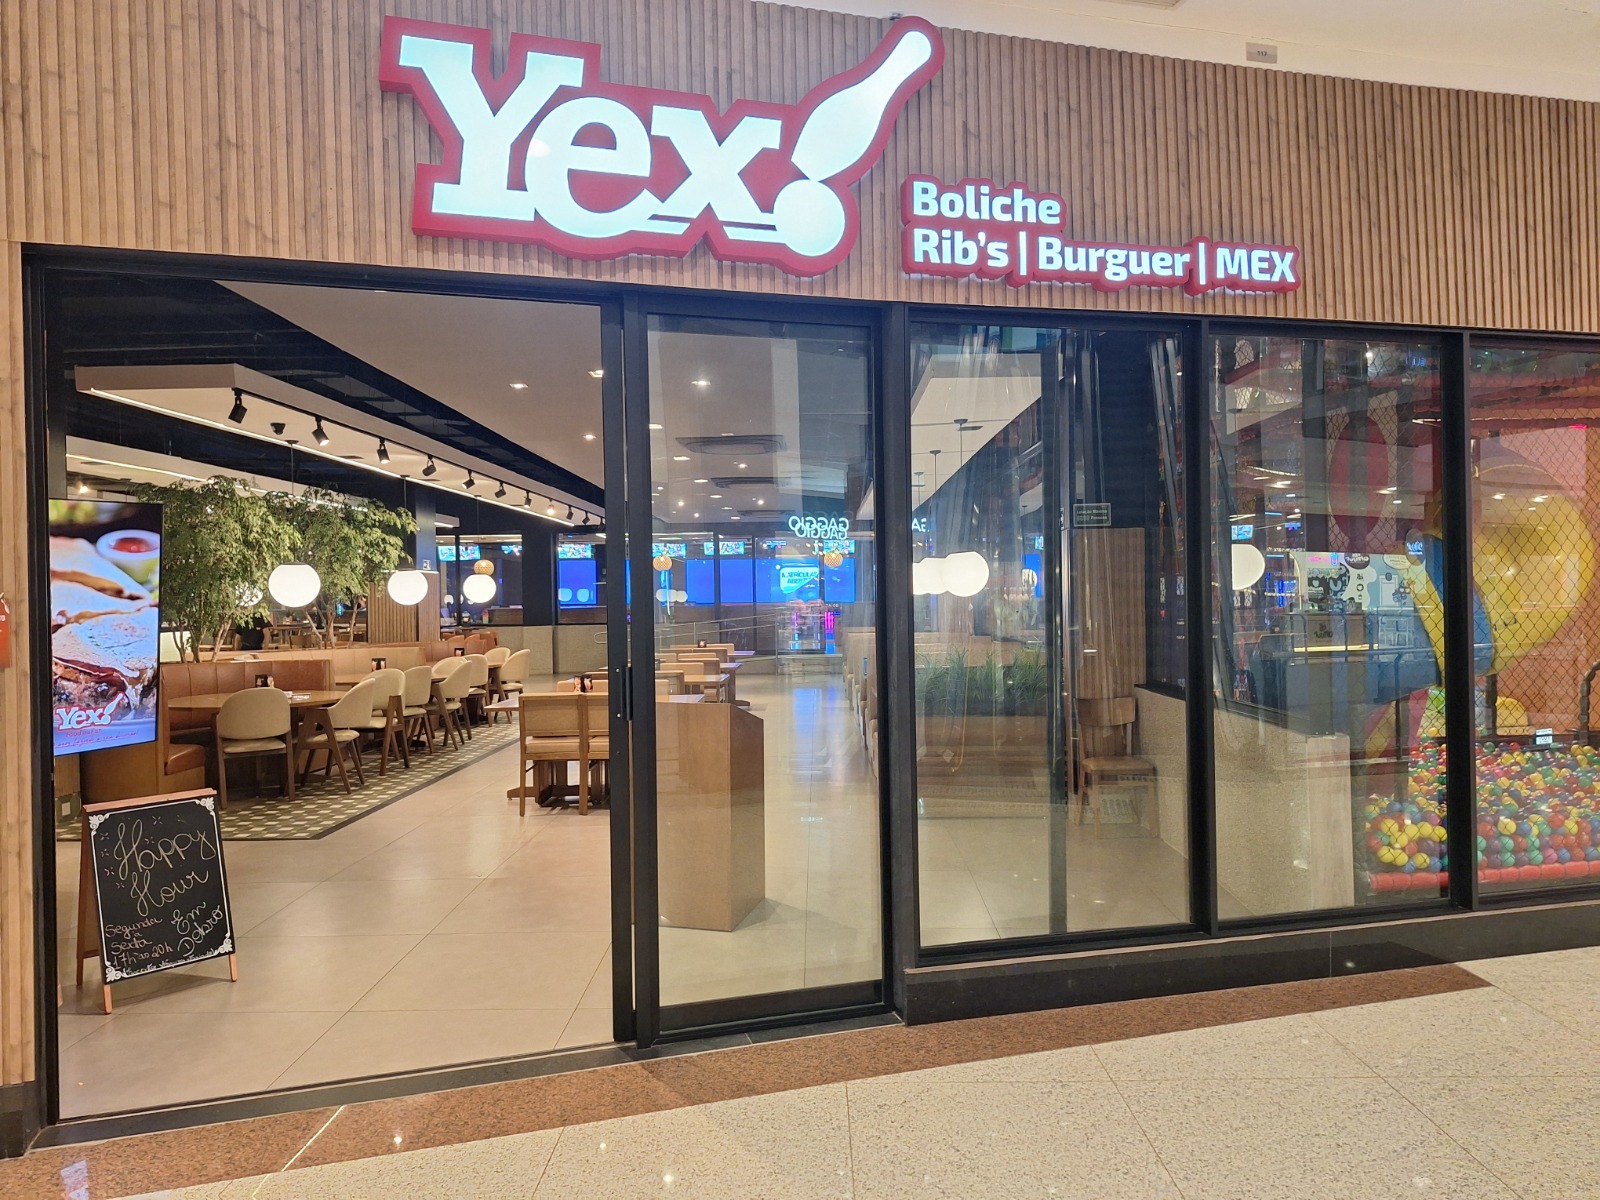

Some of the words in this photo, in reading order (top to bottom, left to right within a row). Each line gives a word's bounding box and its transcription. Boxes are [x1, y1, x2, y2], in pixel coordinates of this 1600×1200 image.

[912, 180, 1062, 225] Boliche
[912, 227, 1009, 269] Rib's
[1037, 235, 1191, 281] Burguer
[1215, 246, 1297, 283] MEX
[113, 819, 217, 881] Happy
[130, 869, 209, 917] Hour
[171, 901, 207, 935] Em
